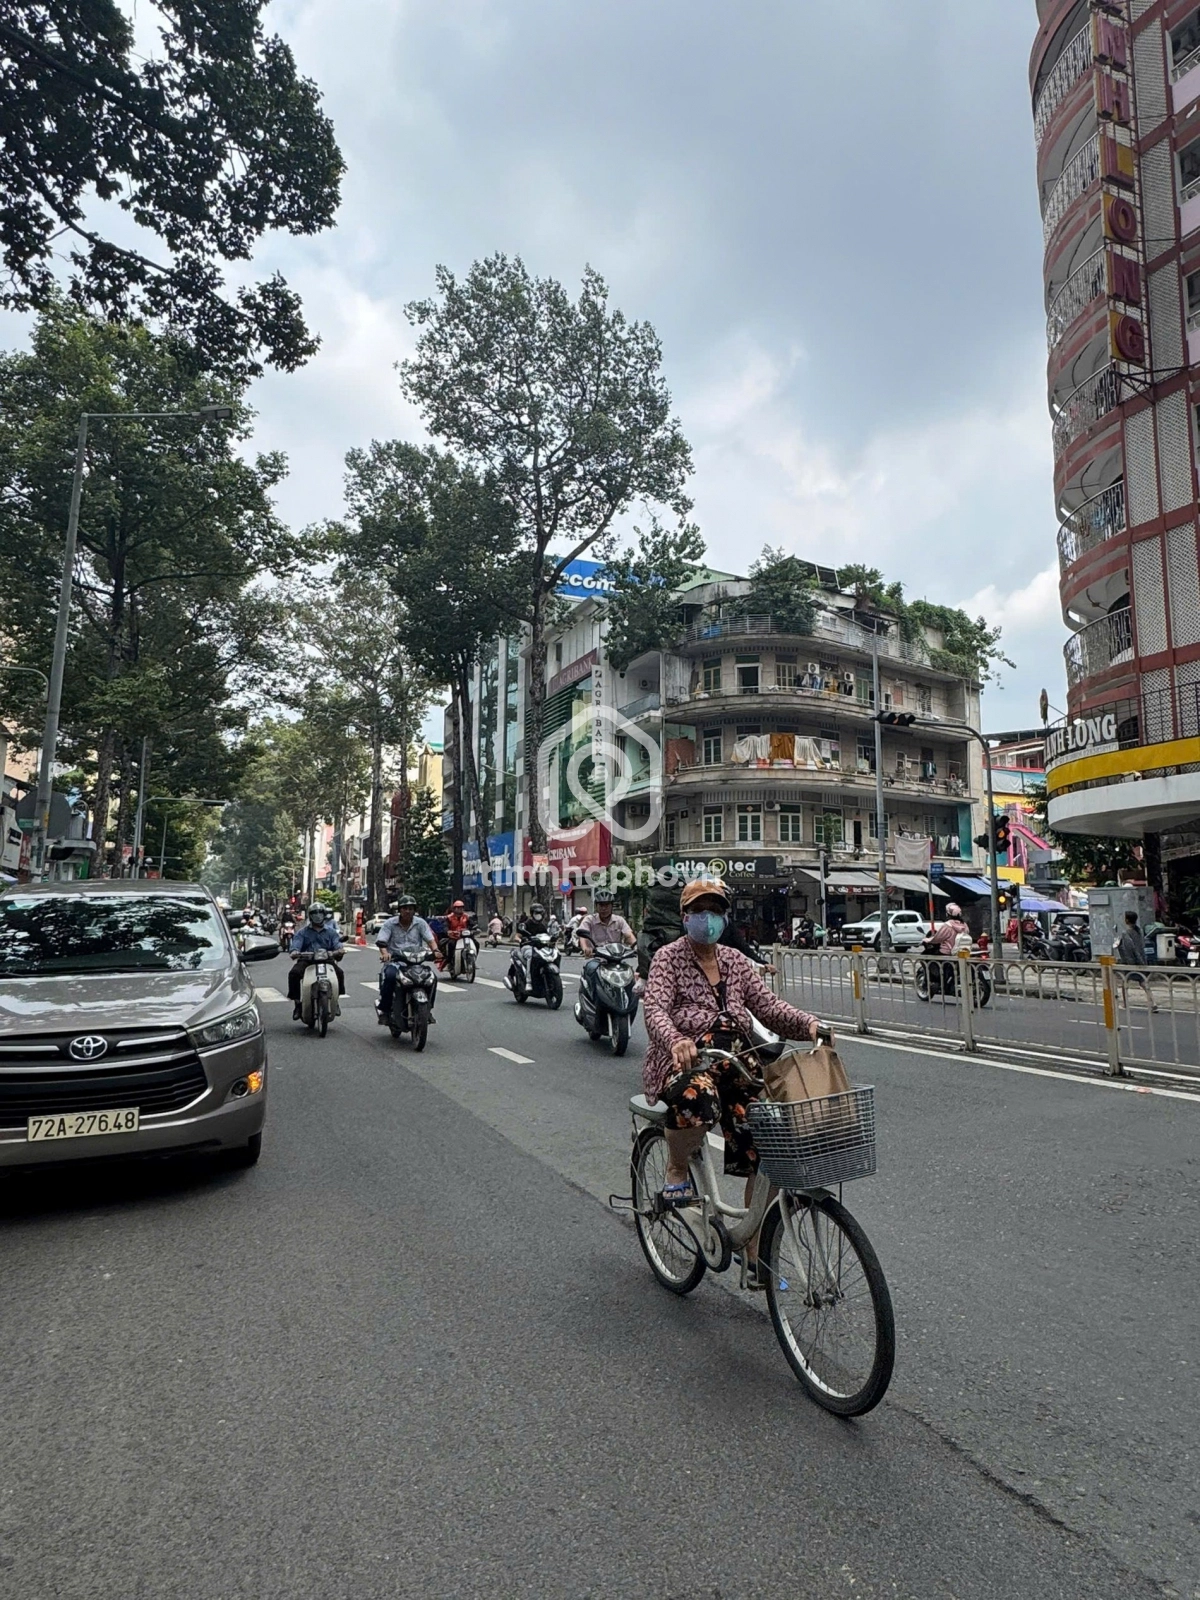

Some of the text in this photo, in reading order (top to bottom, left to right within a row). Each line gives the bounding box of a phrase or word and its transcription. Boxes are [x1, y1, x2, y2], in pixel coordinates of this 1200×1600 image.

[1103, 133, 1146, 364] LONG
[559, 655, 593, 686] AGRIBANK
[594, 681, 603, 756] AGRIBANK
[1067, 713, 1117, 750] LONG
[548, 845, 577, 861] GRIBANK
[728, 860, 755, 872] tea
[728, 870, 756, 878] Coffee
[32, 1111, 135, 1138] 72A-276.48
